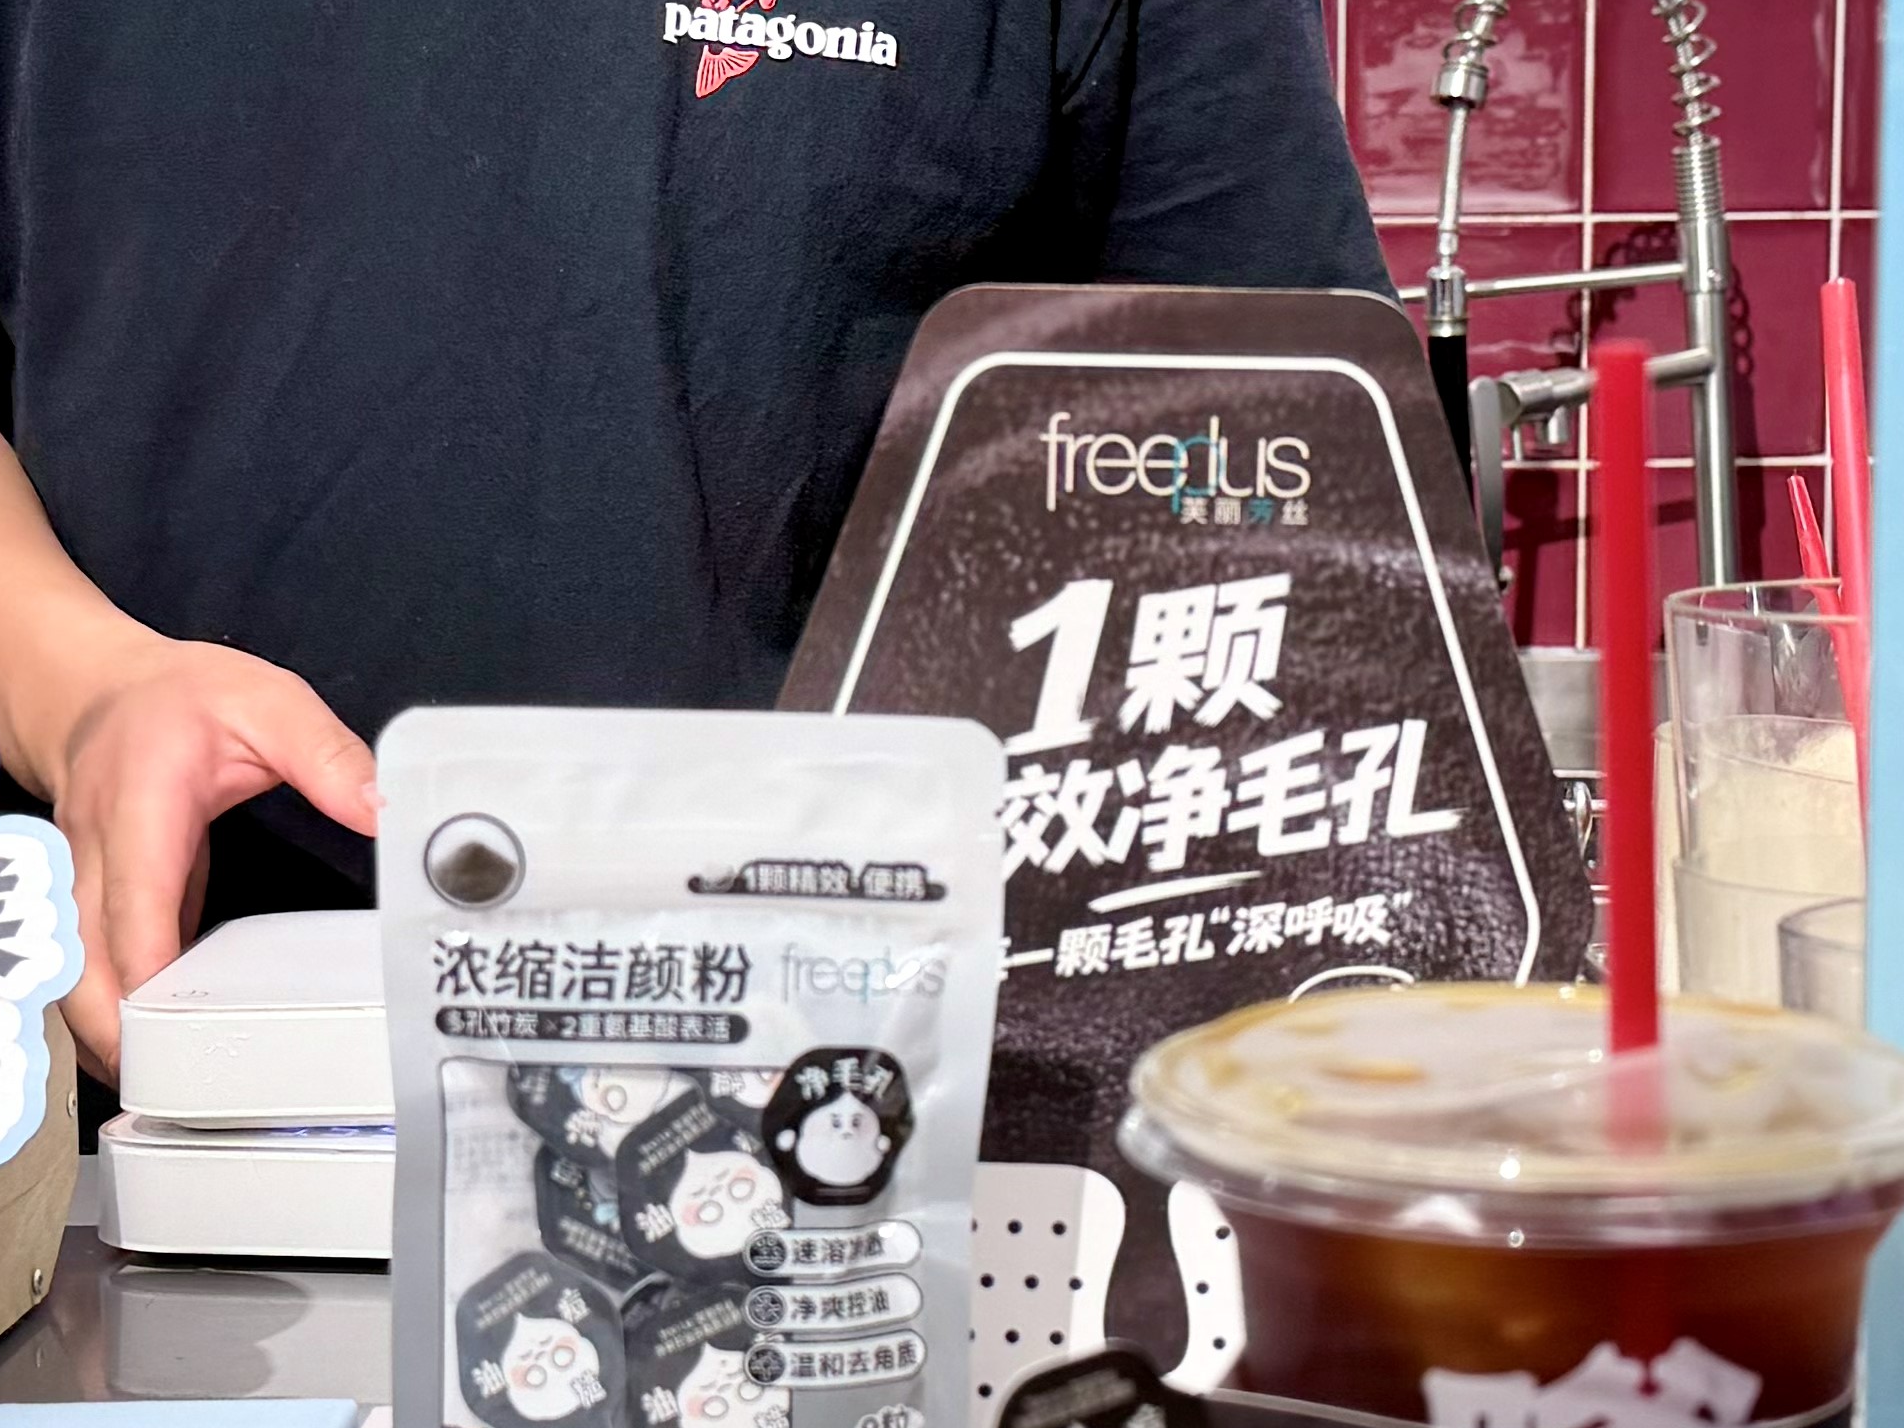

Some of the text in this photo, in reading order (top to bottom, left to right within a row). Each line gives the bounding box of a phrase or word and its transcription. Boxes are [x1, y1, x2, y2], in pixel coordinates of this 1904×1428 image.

[663, 2, 897, 68] patagonia
[1038, 412, 1311, 512] freeplus
[1178, 498, 1310, 526] 芙丽芳丝
[1005, 574, 1293, 756] 1颗
[433, 938, 753, 1004] 浓缩洁颜粉
[791, 1288, 889, 1321] 净爽控油
[791, 1340, 918, 1378] 温和去角质
